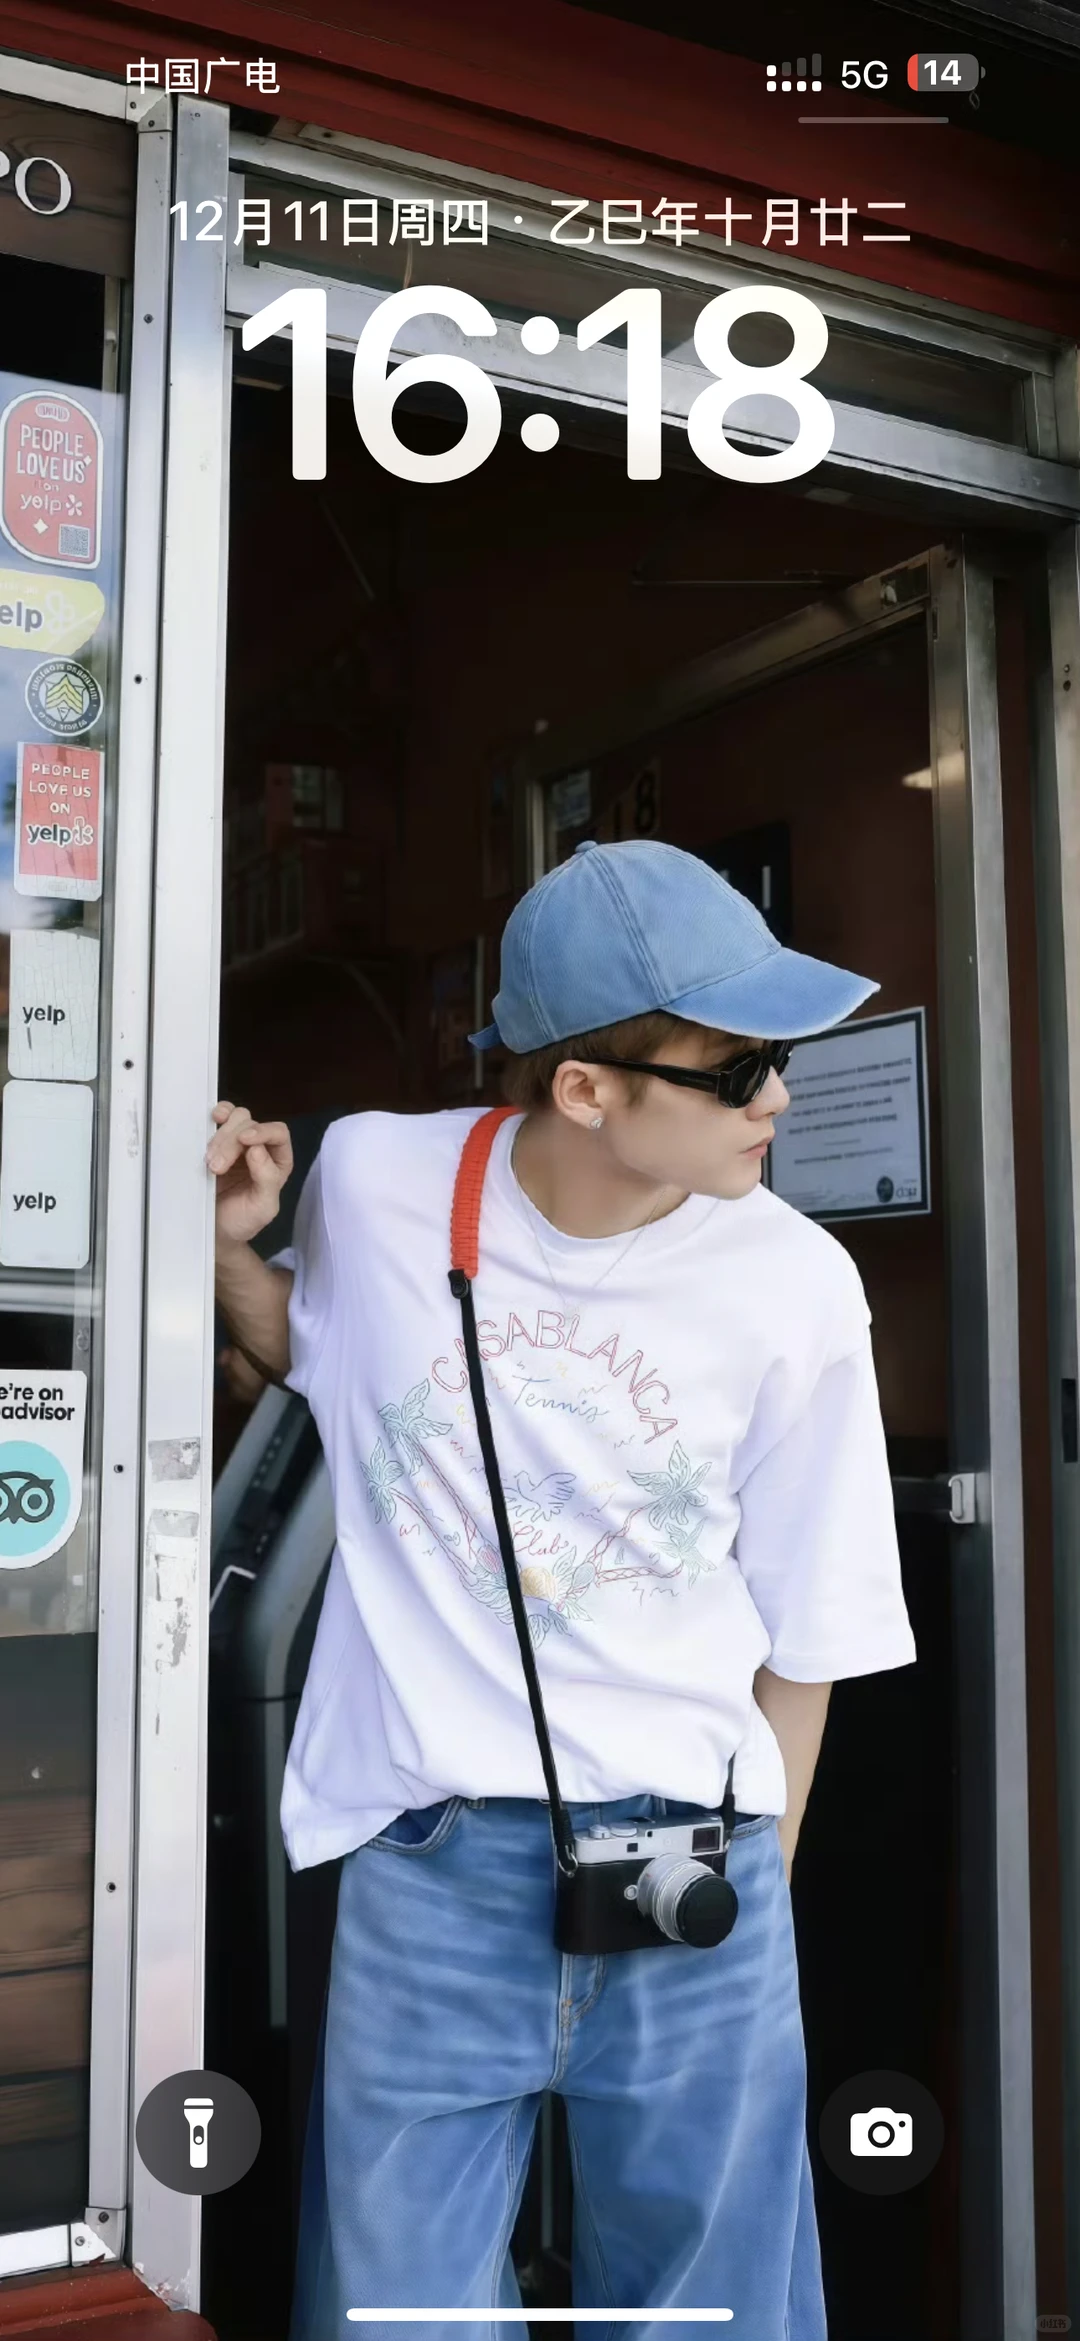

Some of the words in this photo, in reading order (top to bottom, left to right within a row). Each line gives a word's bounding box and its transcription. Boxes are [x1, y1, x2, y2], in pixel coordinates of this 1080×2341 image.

[0, 151, 71, 215] O
[20, 424, 84, 457] PEOPLE
[16, 450, 61, 480] LOVE
[62, 458, 85, 484] US
[20, 494, 62, 515] yelp
[0, 602, 43, 632] elp
[31, 763, 90, 780] PEOPLE
[29, 780, 68, 796] LOVE
[72, 785, 92, 798] US
[50, 803, 70, 815] ON
[28, 824, 71, 844] yelp
[22, 1005, 66, 1025] yelp
[12, 1192, 57, 1213] yelp
[38, 1387, 63, 1401] on
[512, 1374, 610, 1424] Tennis
[512, 1520, 569, 1557] Club
